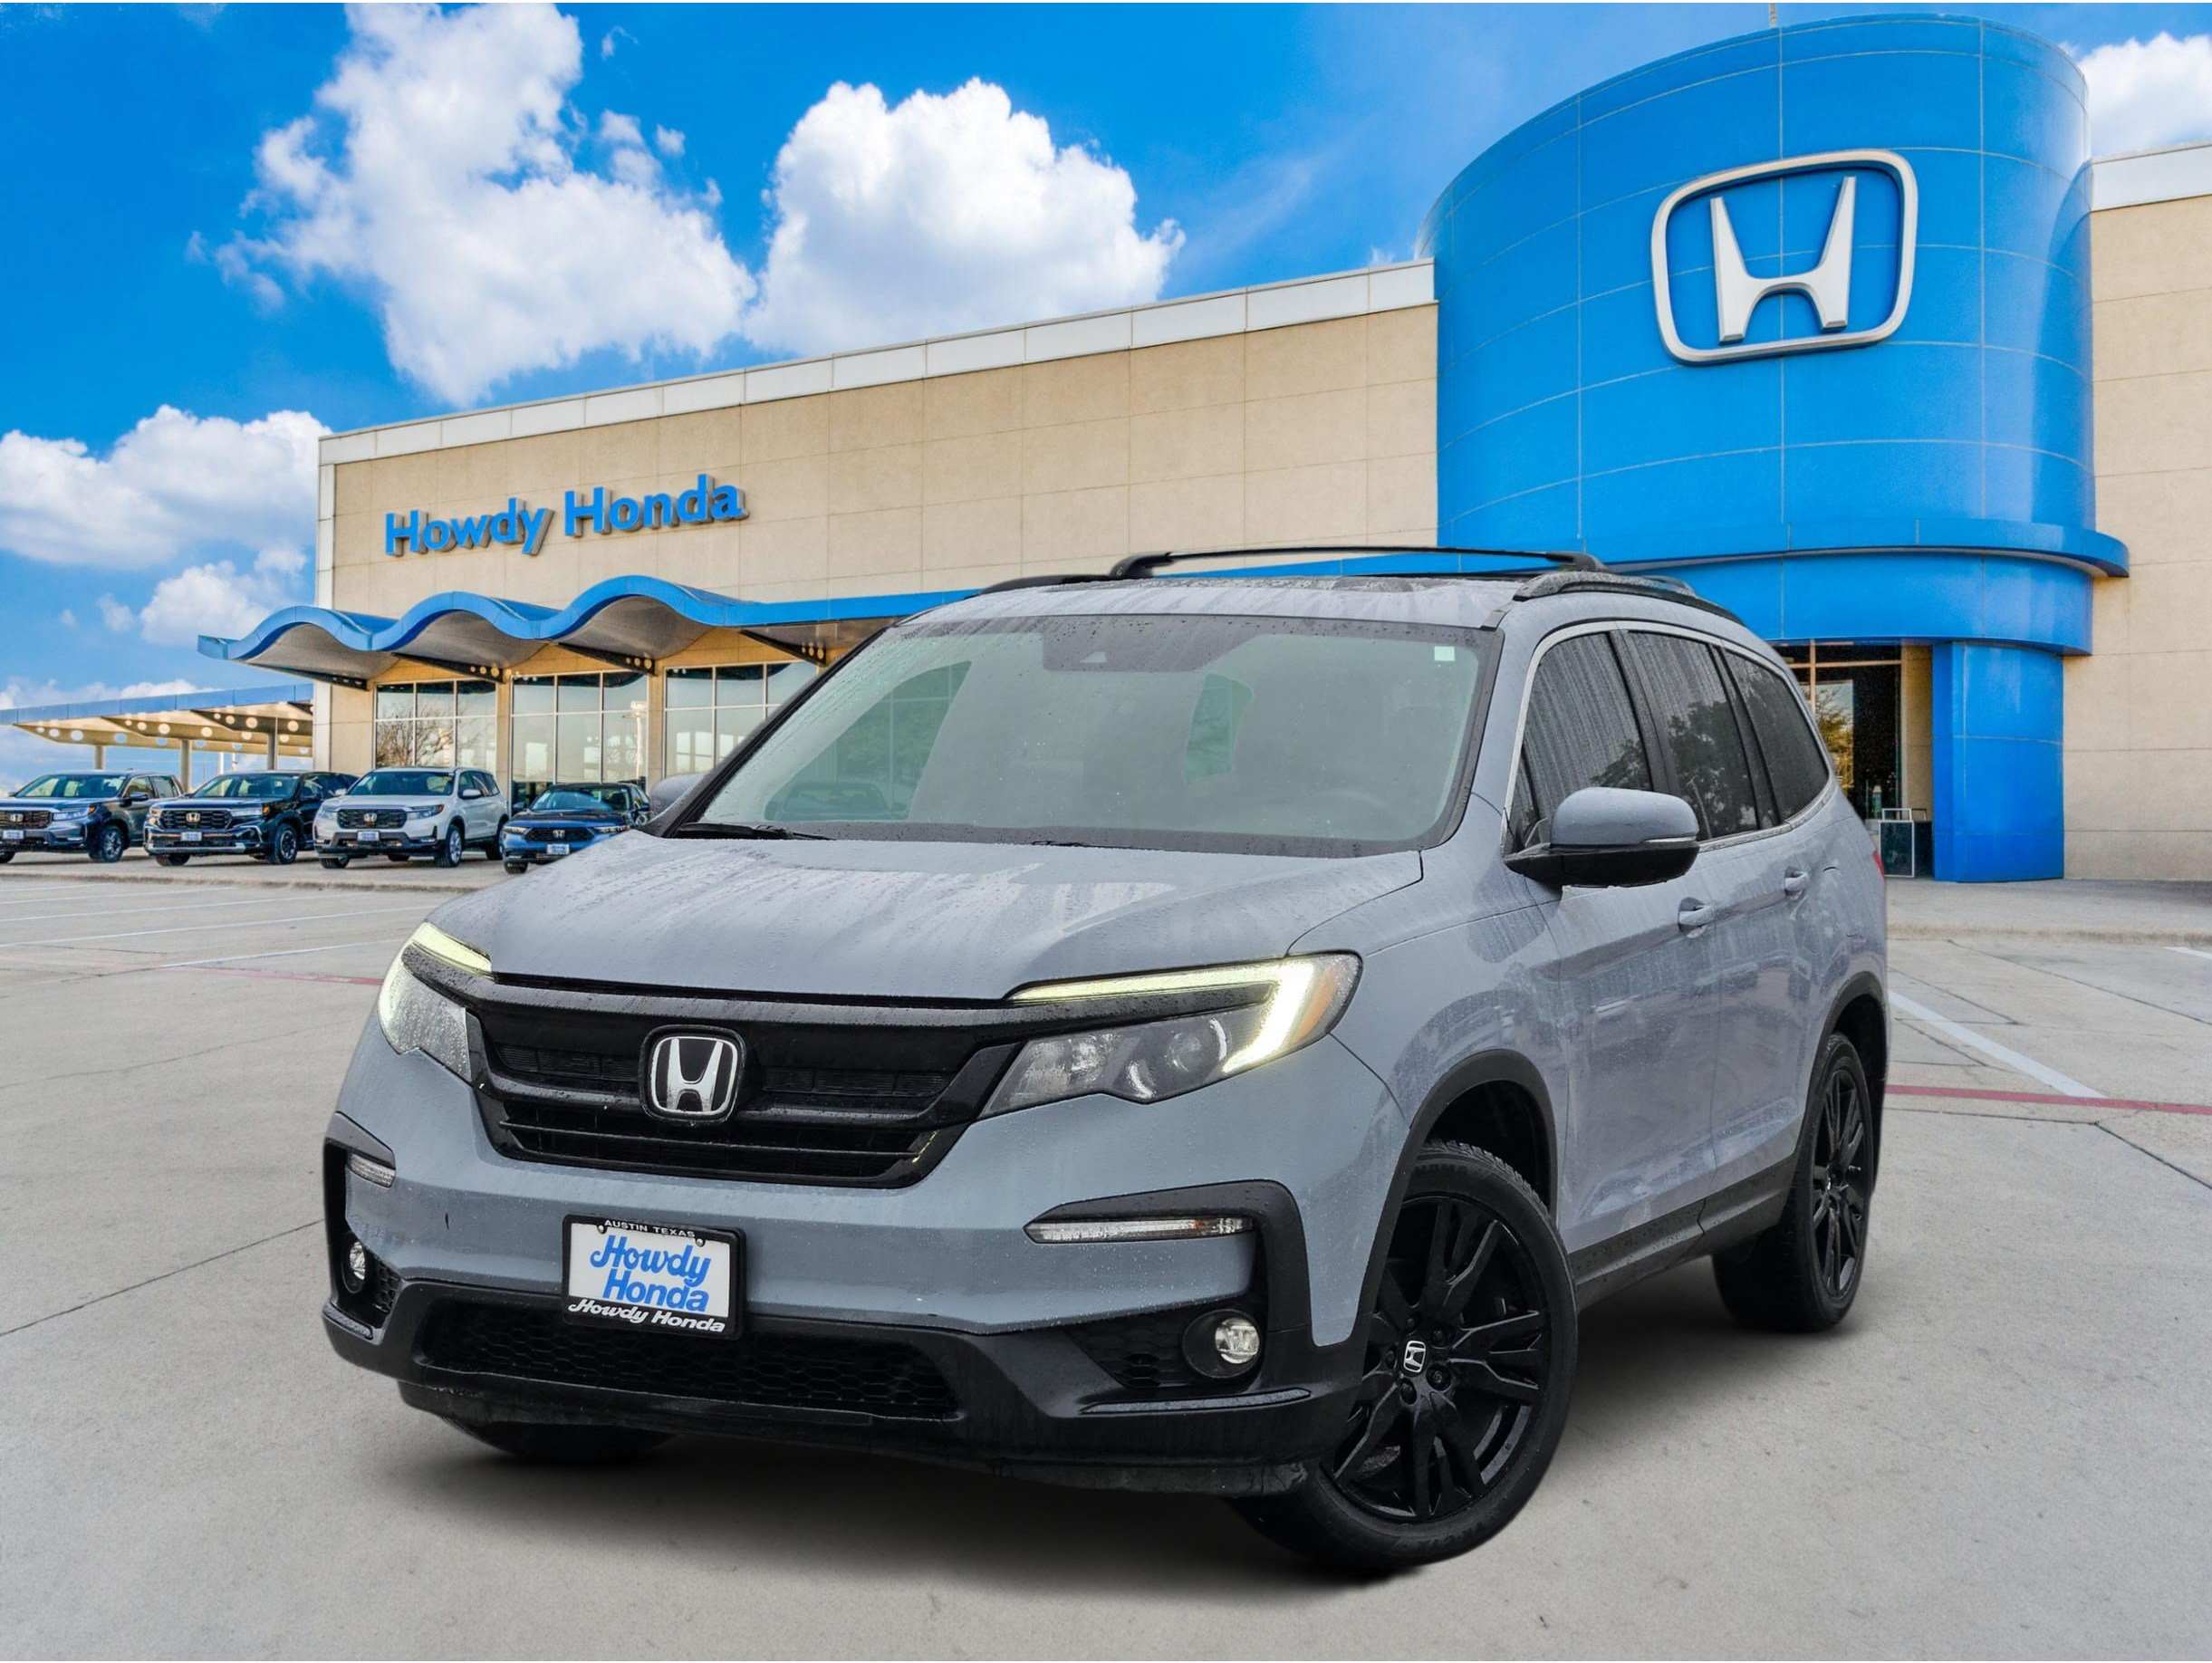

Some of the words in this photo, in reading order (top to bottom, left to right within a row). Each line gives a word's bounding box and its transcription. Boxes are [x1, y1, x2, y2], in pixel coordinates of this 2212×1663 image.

[385, 496, 554, 556] Howdy
[564, 474, 749, 537] Honda
[604, 1219, 648, 1232] AUSTIN
[652, 1226, 695, 1237] TEXAS
[590, 1235, 711, 1287] Howdy
[602, 1269, 709, 1312] Honda
[568, 1299, 649, 1323] Howdy
[651, 1310, 726, 1332] Honda
